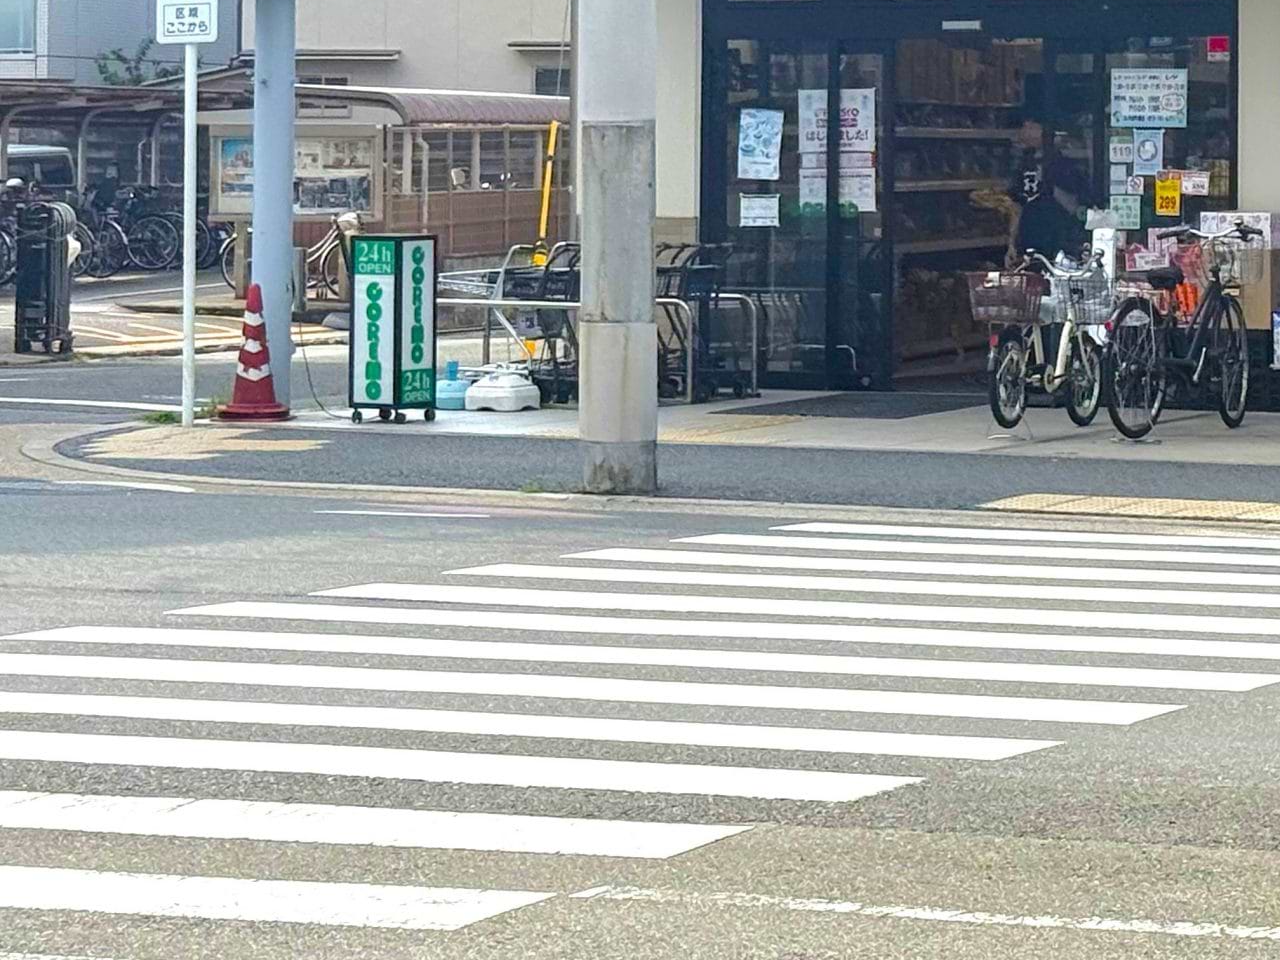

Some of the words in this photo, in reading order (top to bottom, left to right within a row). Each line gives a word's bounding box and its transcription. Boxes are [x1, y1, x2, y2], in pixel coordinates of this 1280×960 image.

[166, 21, 209, 33] ここから
[358, 263, 391, 273] OPEN
[403, 390, 431, 402] OPEN
